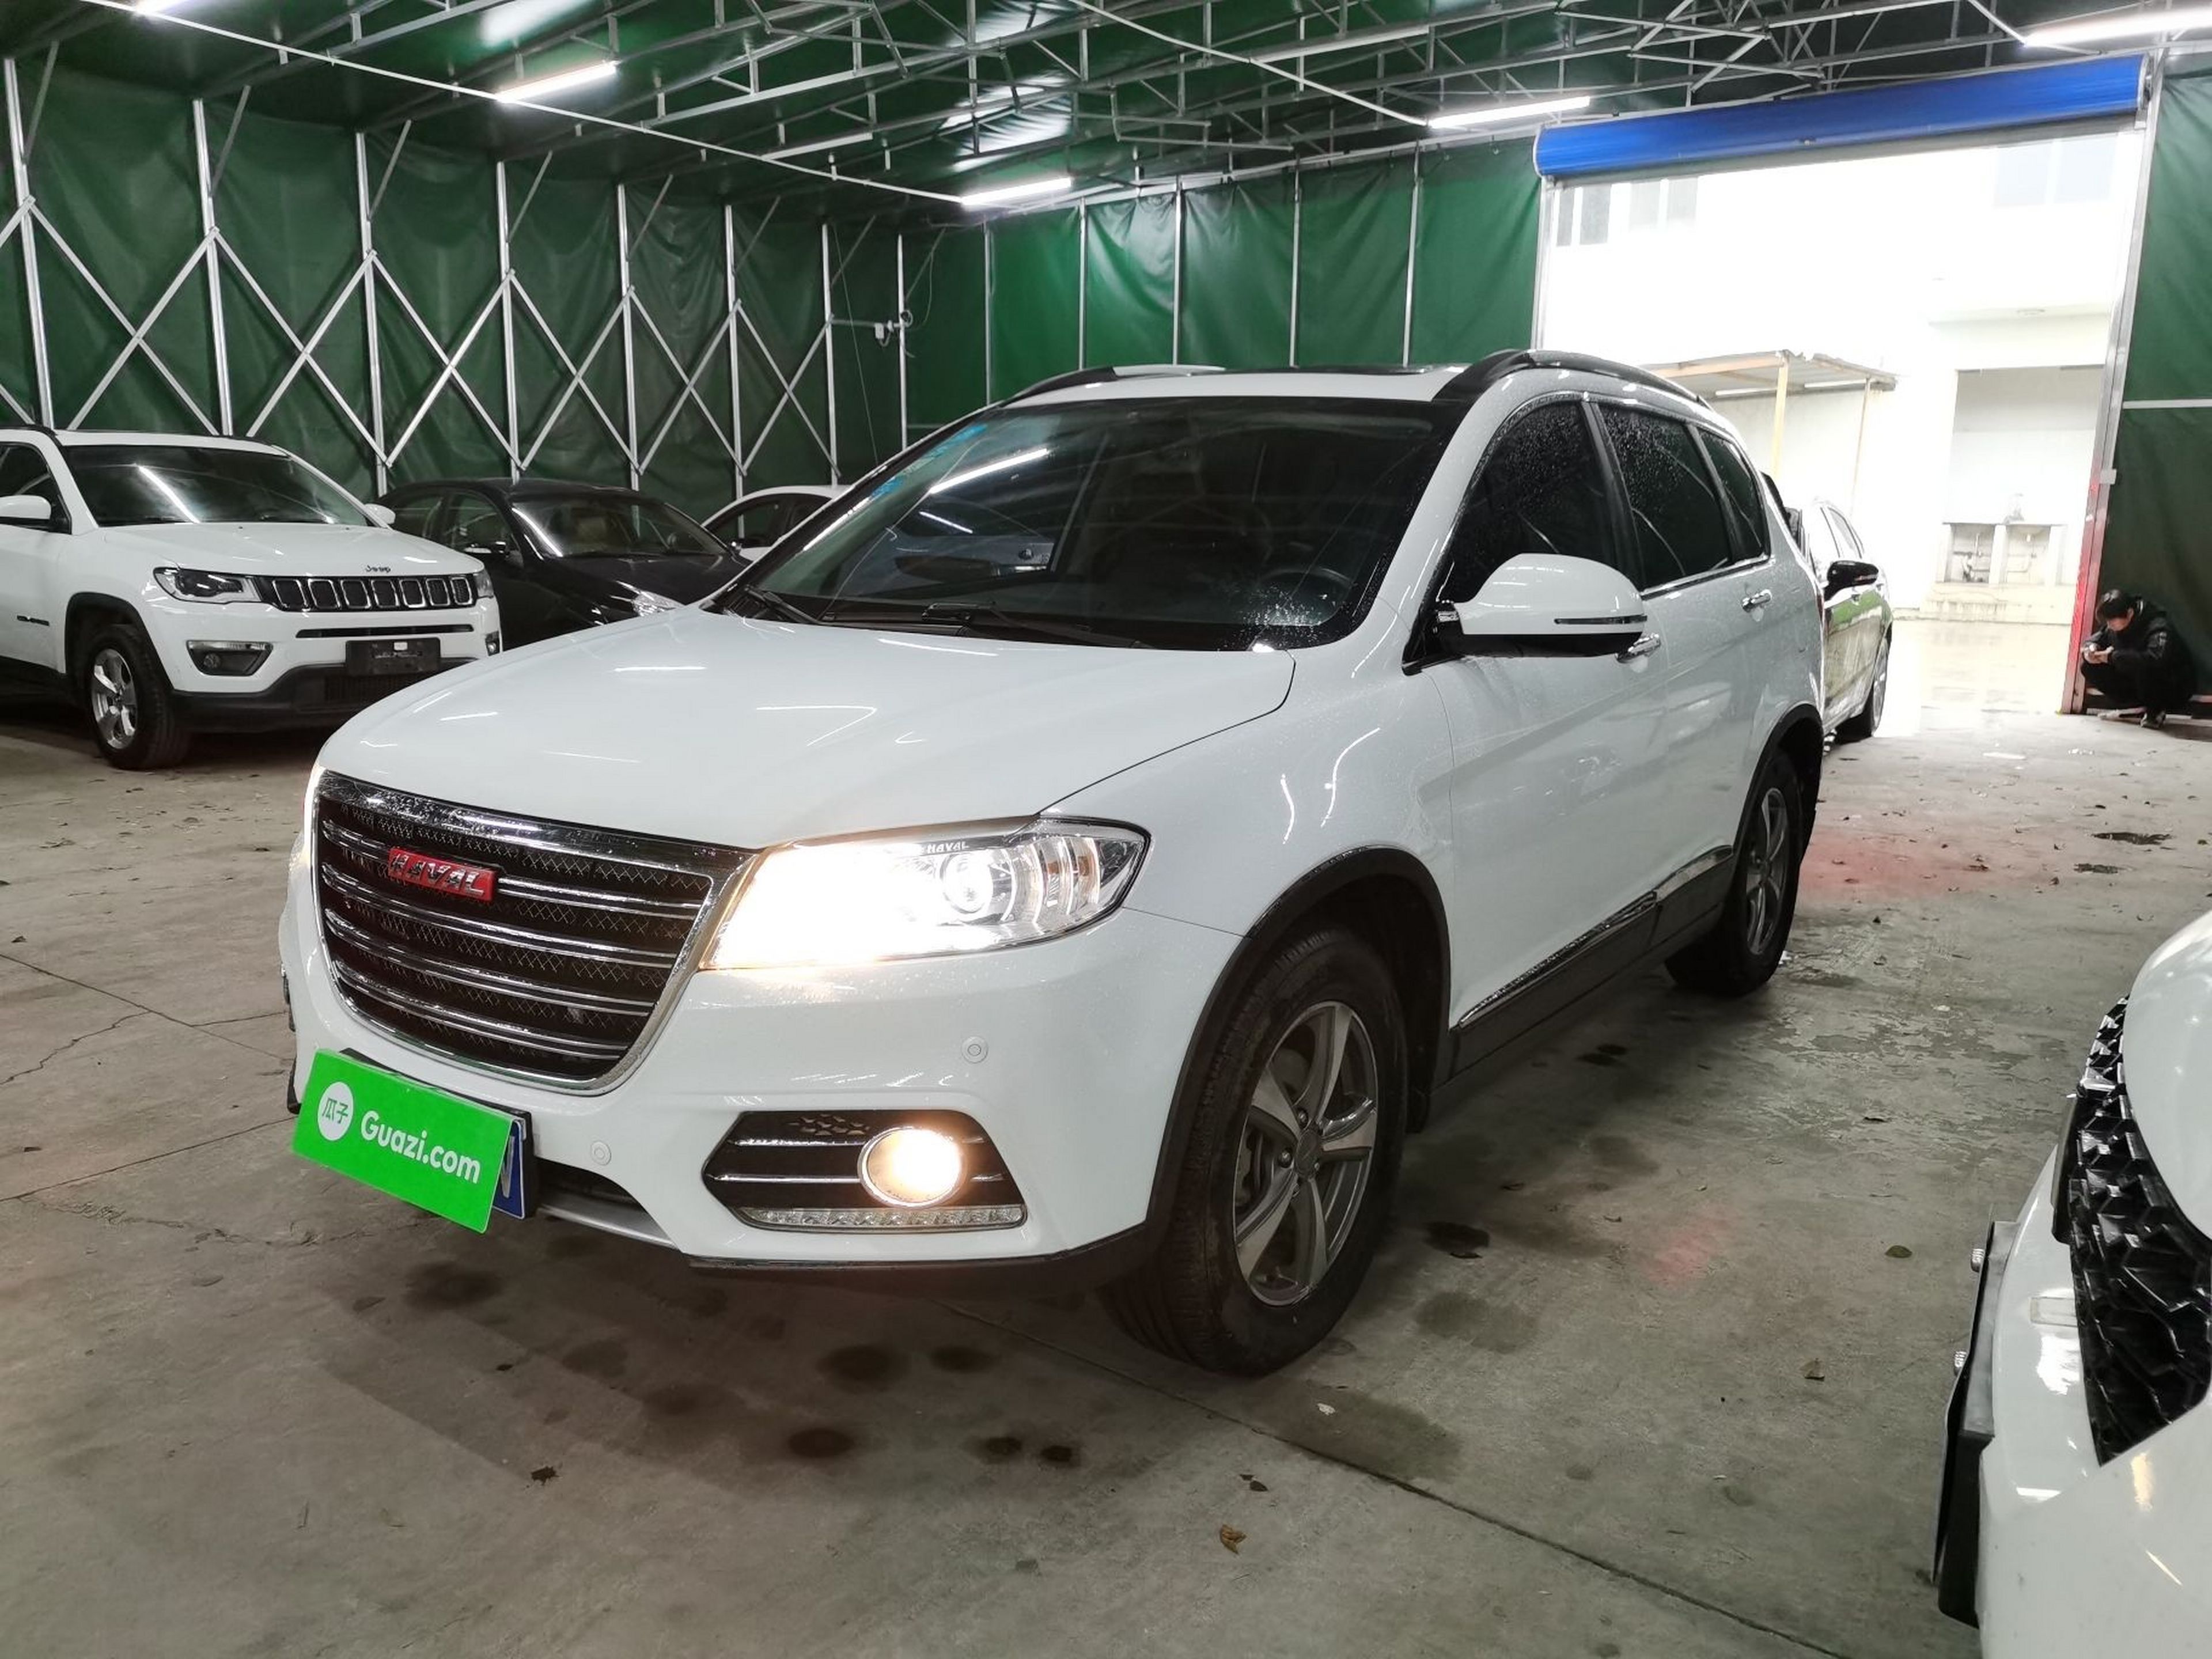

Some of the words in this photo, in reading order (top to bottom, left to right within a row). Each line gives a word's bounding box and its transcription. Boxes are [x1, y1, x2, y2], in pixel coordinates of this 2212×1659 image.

[927, 841, 969, 854] HAVAL
[321, 1097, 349, 1124] 瓜子
[361, 1110, 481, 1184] Guazi.com
